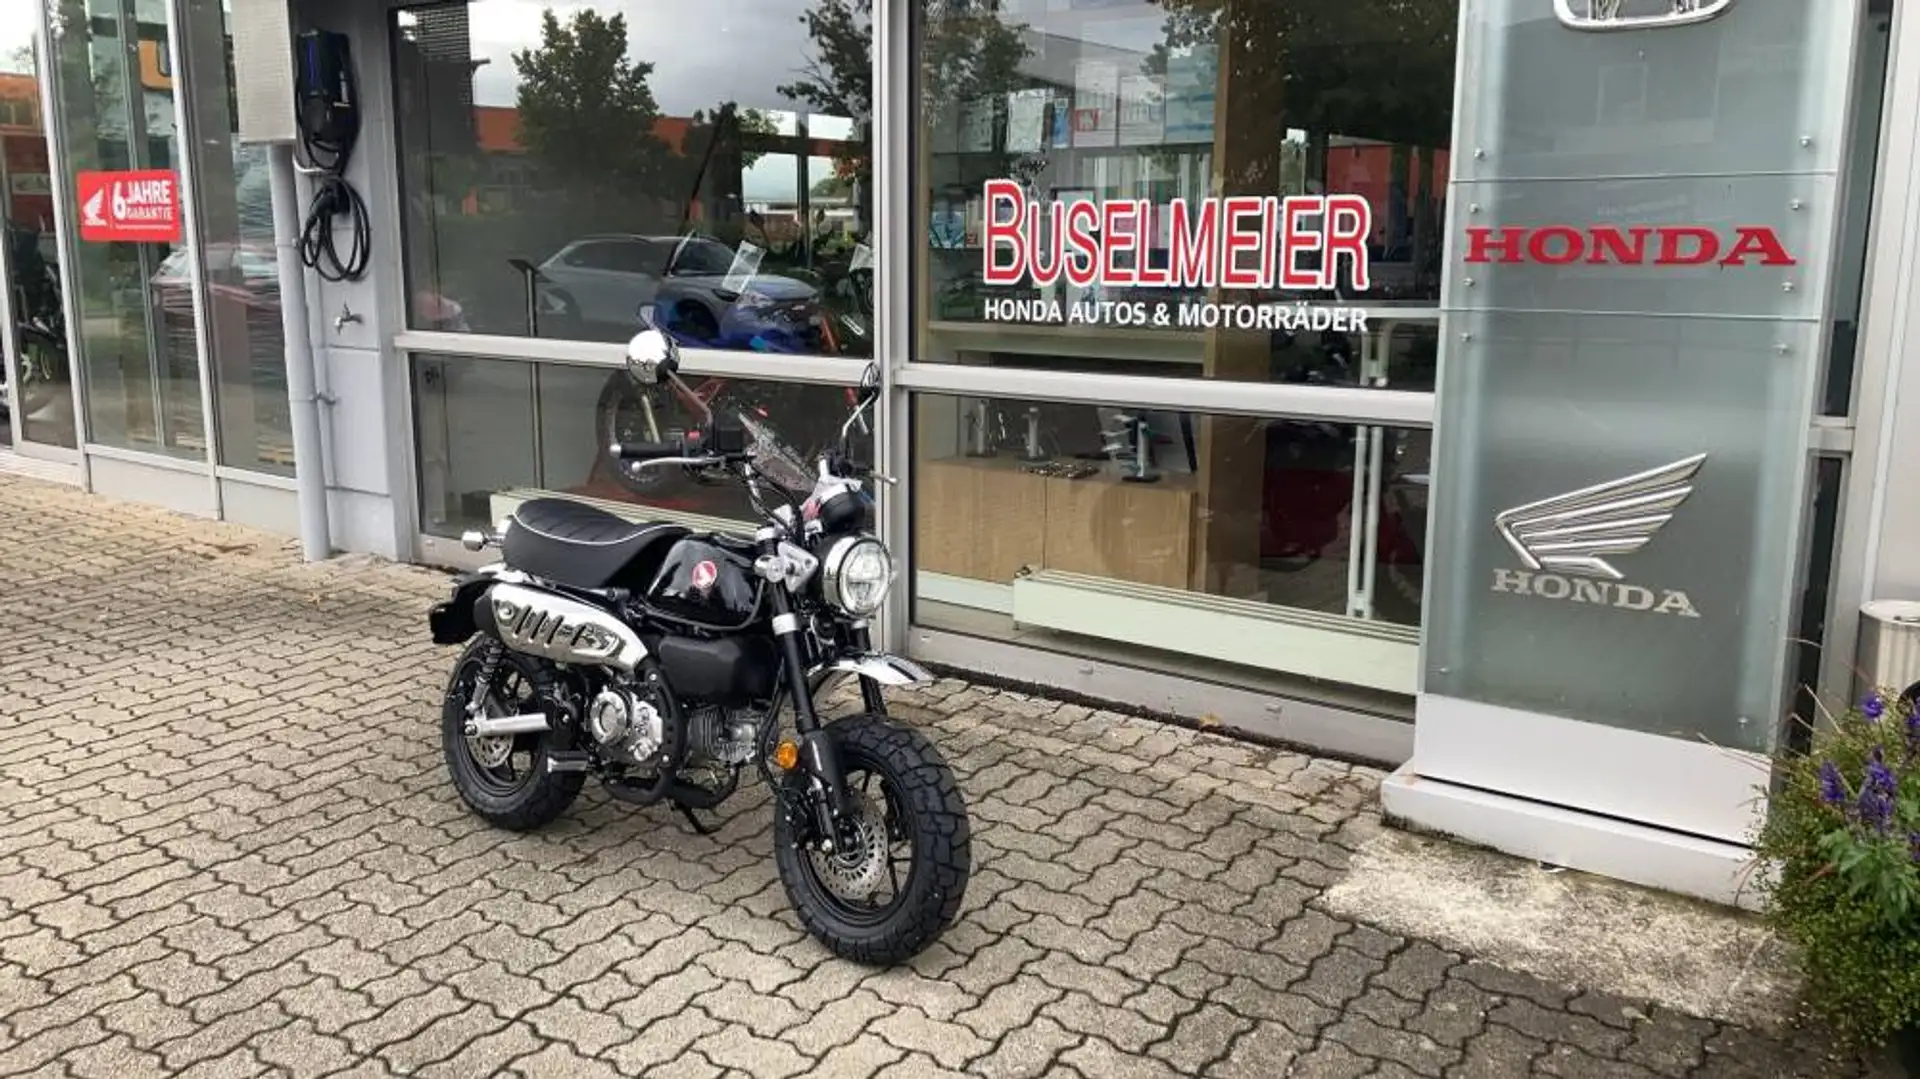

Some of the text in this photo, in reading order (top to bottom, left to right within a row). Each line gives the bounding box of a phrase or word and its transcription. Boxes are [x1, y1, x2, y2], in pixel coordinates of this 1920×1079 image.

[112, 180, 172, 220] 6 JAHRE
[984, 179, 1371, 290] BUSELMEIER
[1464, 227, 1796, 266] HONDA
[984, 298, 1368, 332] HONDA AUTOS & MOTORRÄDER
[1490, 567, 1702, 618] HONDA
